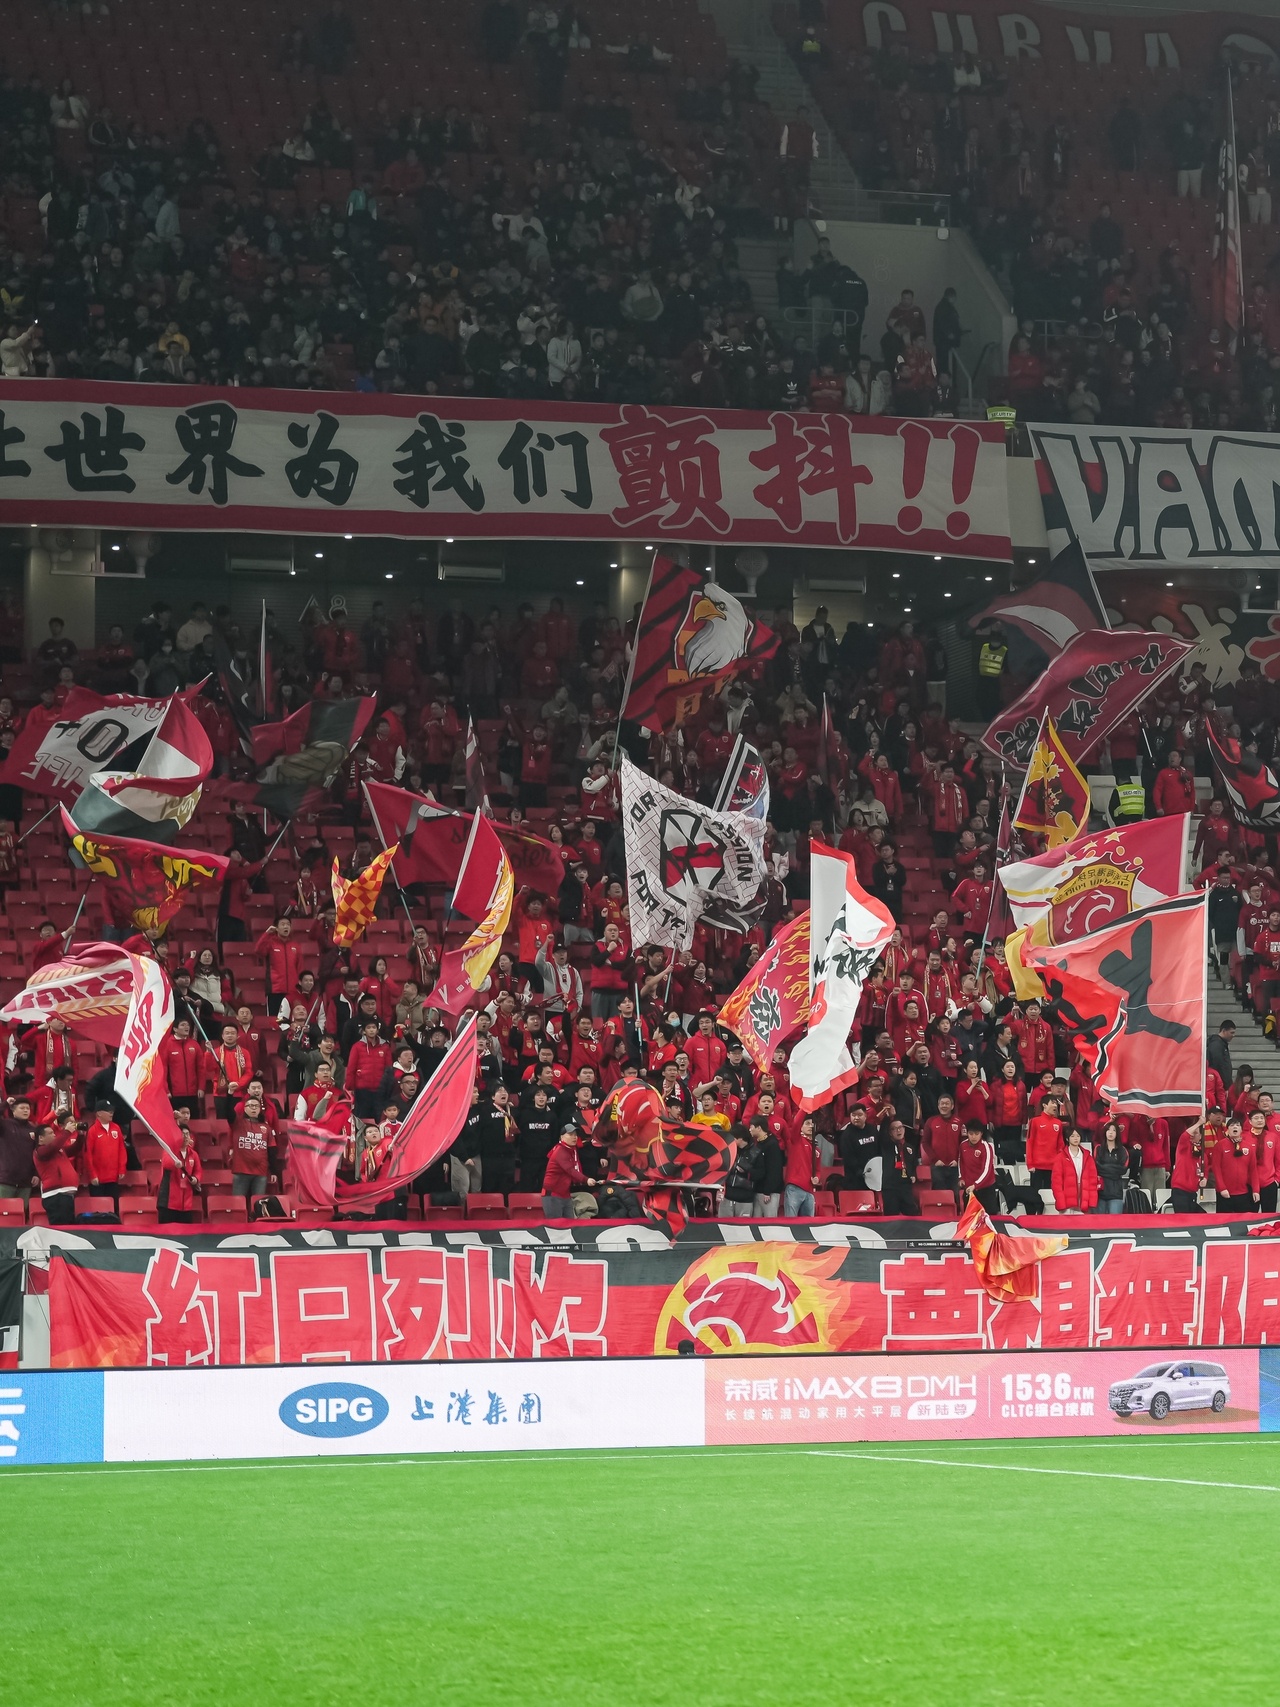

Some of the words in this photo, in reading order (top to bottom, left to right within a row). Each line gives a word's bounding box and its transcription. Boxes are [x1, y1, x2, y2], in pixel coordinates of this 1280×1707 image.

[724, 1377, 779, 1401] 荣威
[906, 1375, 977, 1398] DMH
[1001, 1372, 1072, 1401] 1536
[295, 1397, 375, 1424] SIPG
[724, 1404, 902, 1421] 长续航混动家用大平层
[917, 1403, 968, 1417] 新陆尊
[1001, 1402, 1096, 1419] CLTC综合续航
